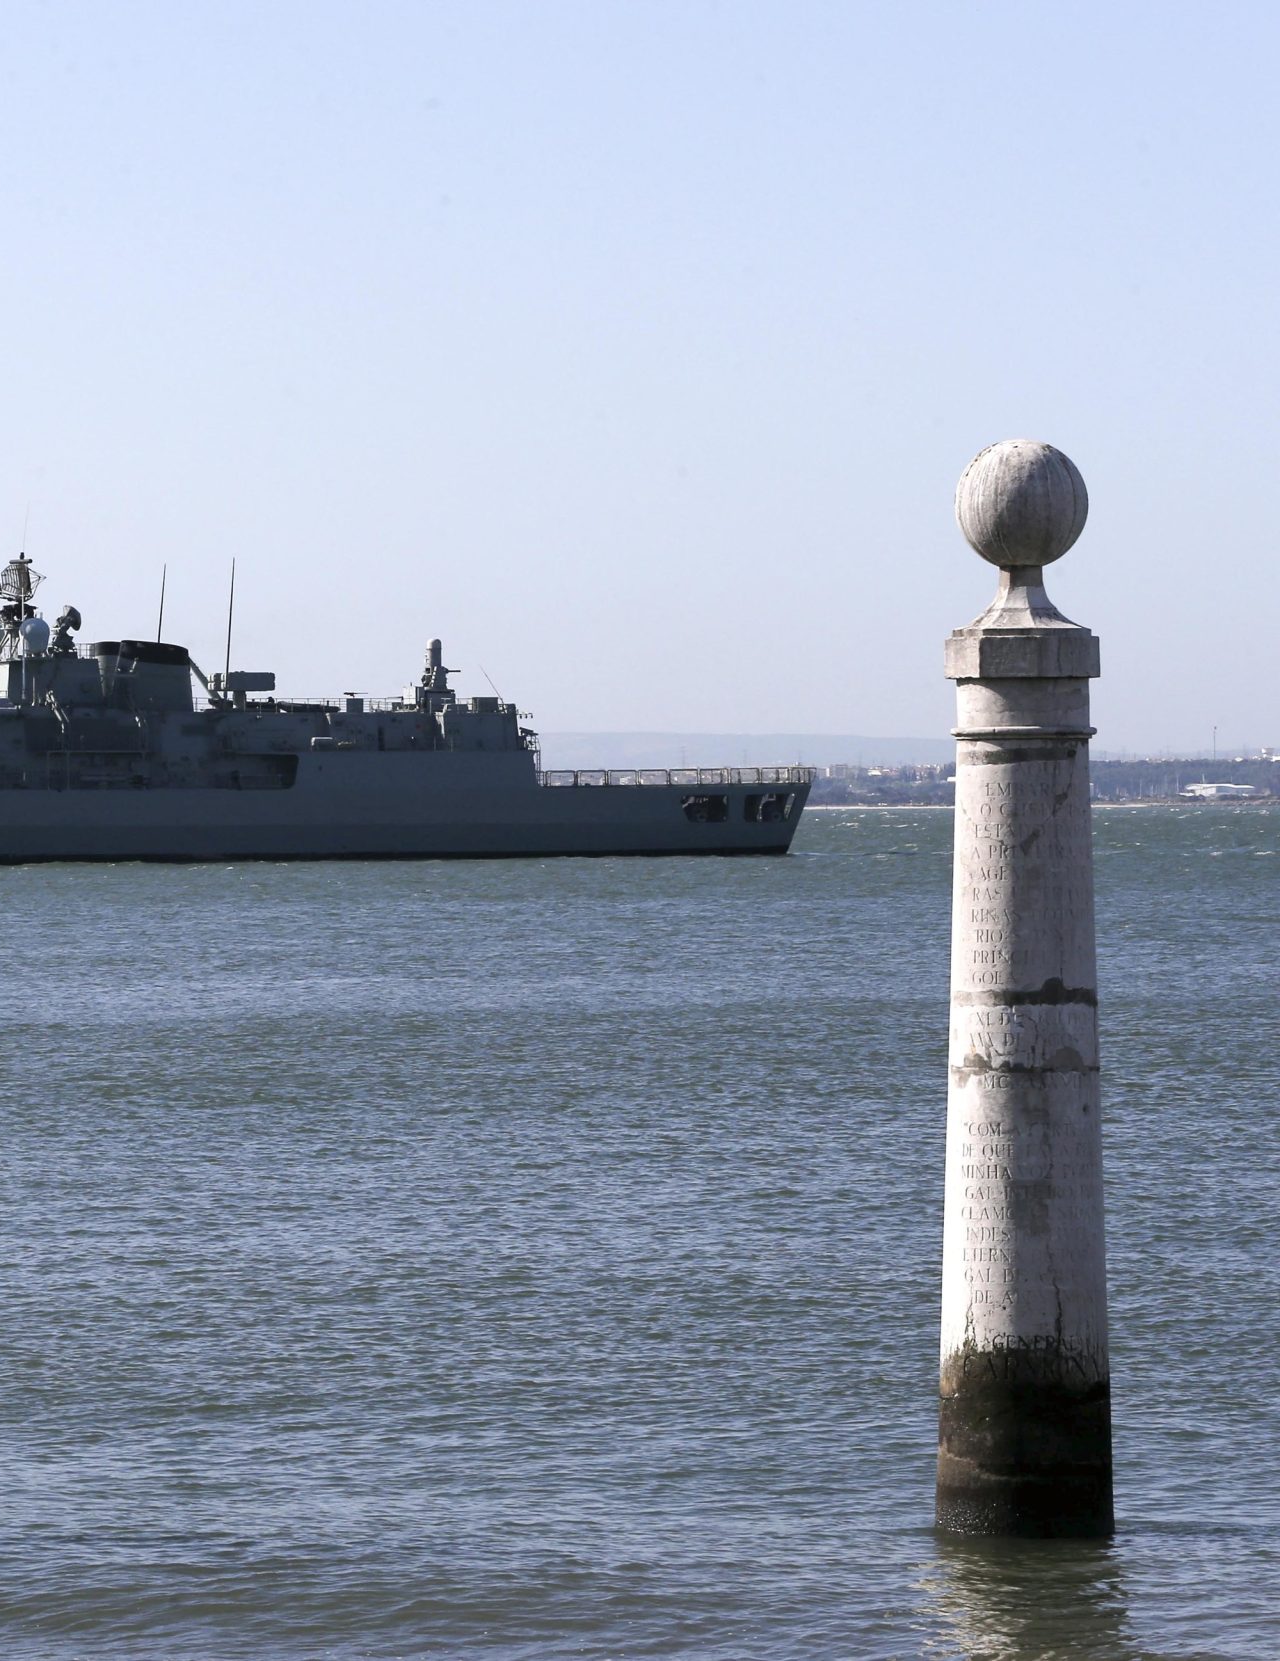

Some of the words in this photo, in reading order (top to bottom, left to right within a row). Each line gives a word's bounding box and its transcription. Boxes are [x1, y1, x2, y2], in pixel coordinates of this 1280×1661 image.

[979, 802, 992, 818] O
[972, 886, 1002, 903] RAS
[982, 1142, 1016, 1162] QUE
[961, 1163, 1013, 1181] MINHA
[964, 1185, 994, 1202] GAL
[964, 1267, 996, 1284] GAL
[974, 1288, 994, 1305] DE
